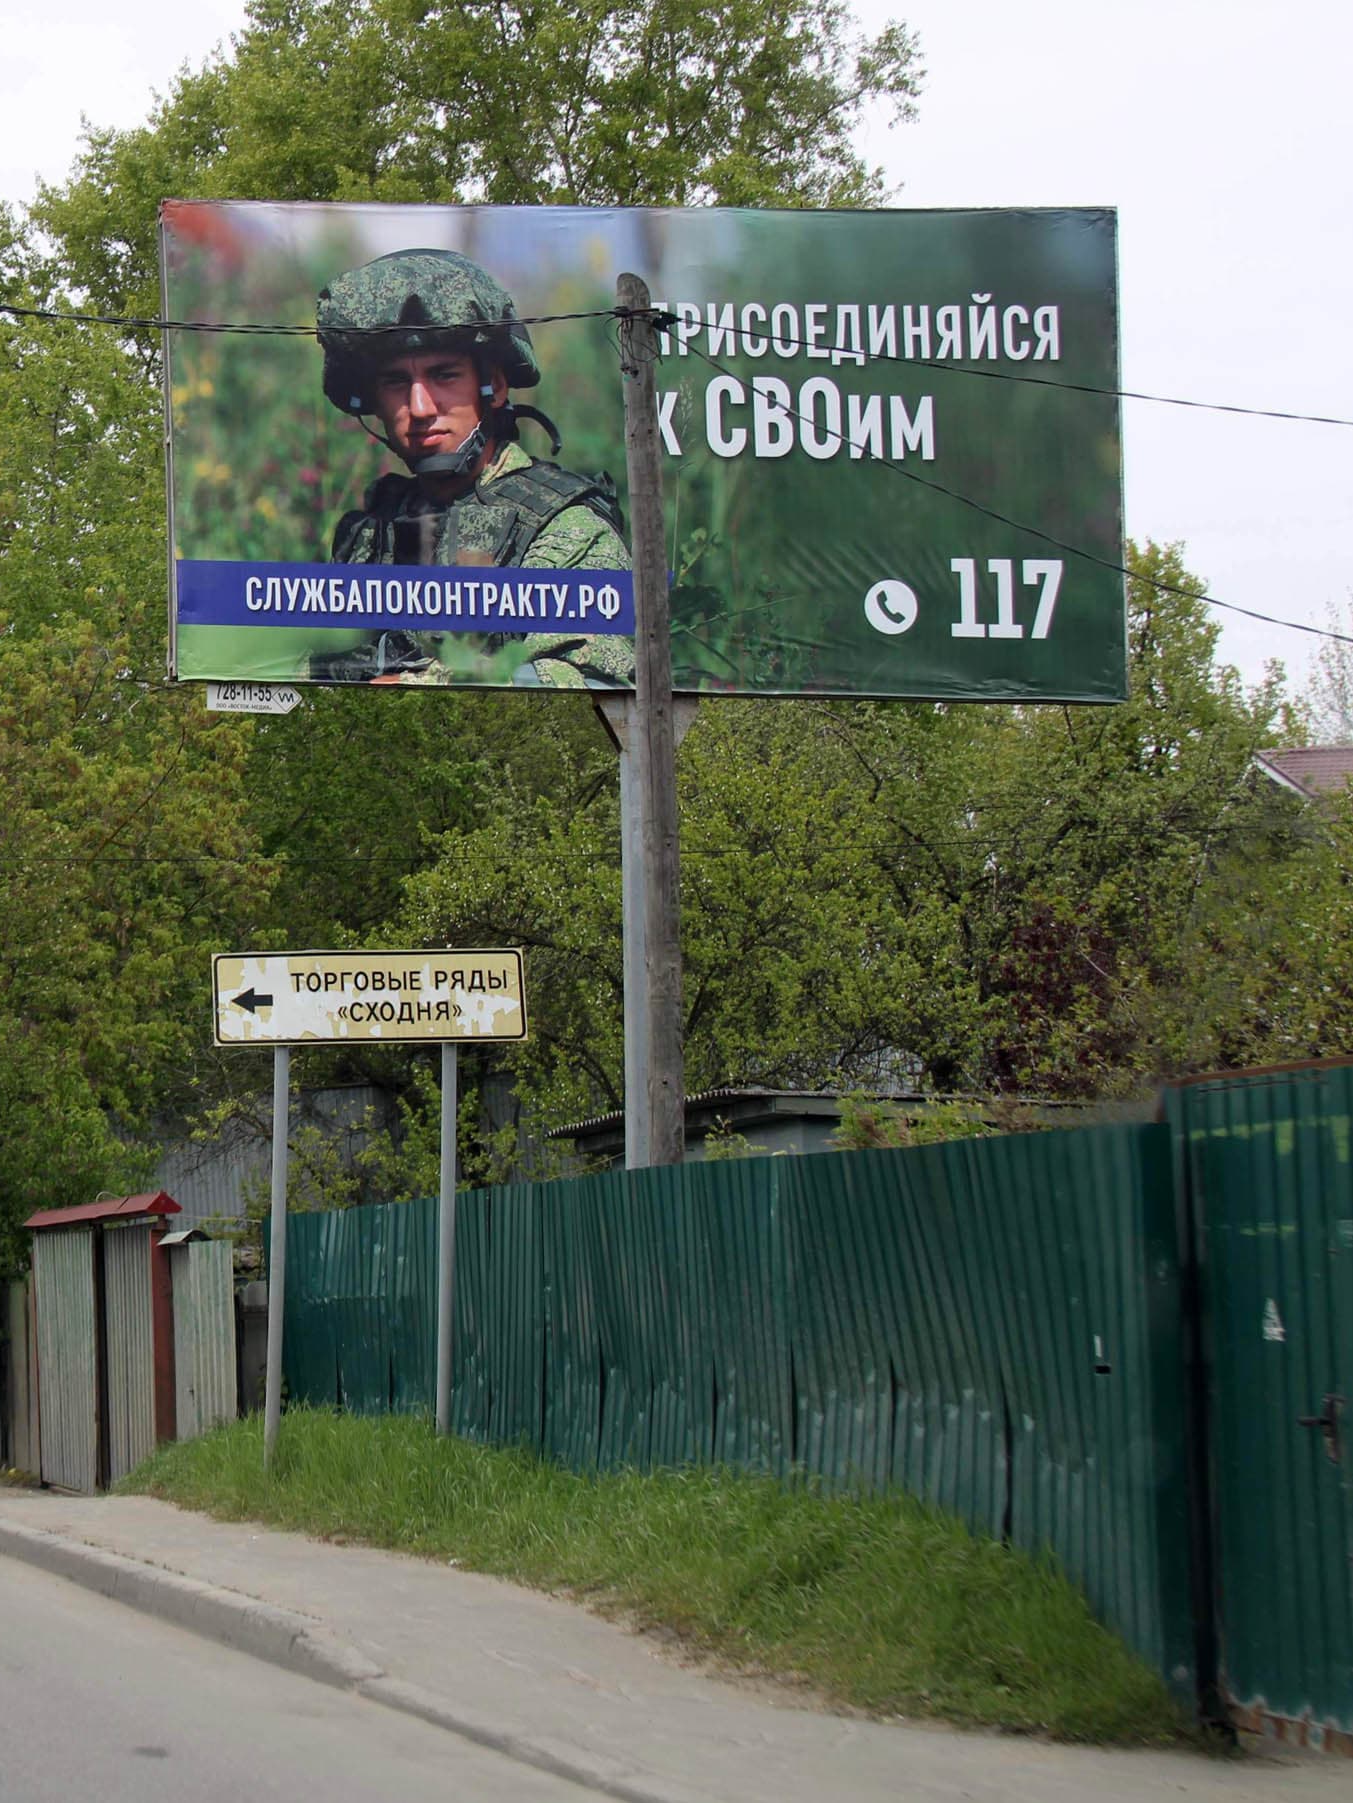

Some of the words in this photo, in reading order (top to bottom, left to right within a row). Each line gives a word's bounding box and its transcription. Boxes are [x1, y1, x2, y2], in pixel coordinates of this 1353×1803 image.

[246, 576, 621, 620] СЛУЖБАПОКОНТРАКТУ.РФ
[950, 558, 1064, 640] 117
[216, 683, 272, 701] 728-11-55
[290, 971, 422, 992] ТОРГОВЫЕ
[434, 969, 508, 993] РЯДЫ
[337, 1001, 462, 1025] «СХОДНЯ»
